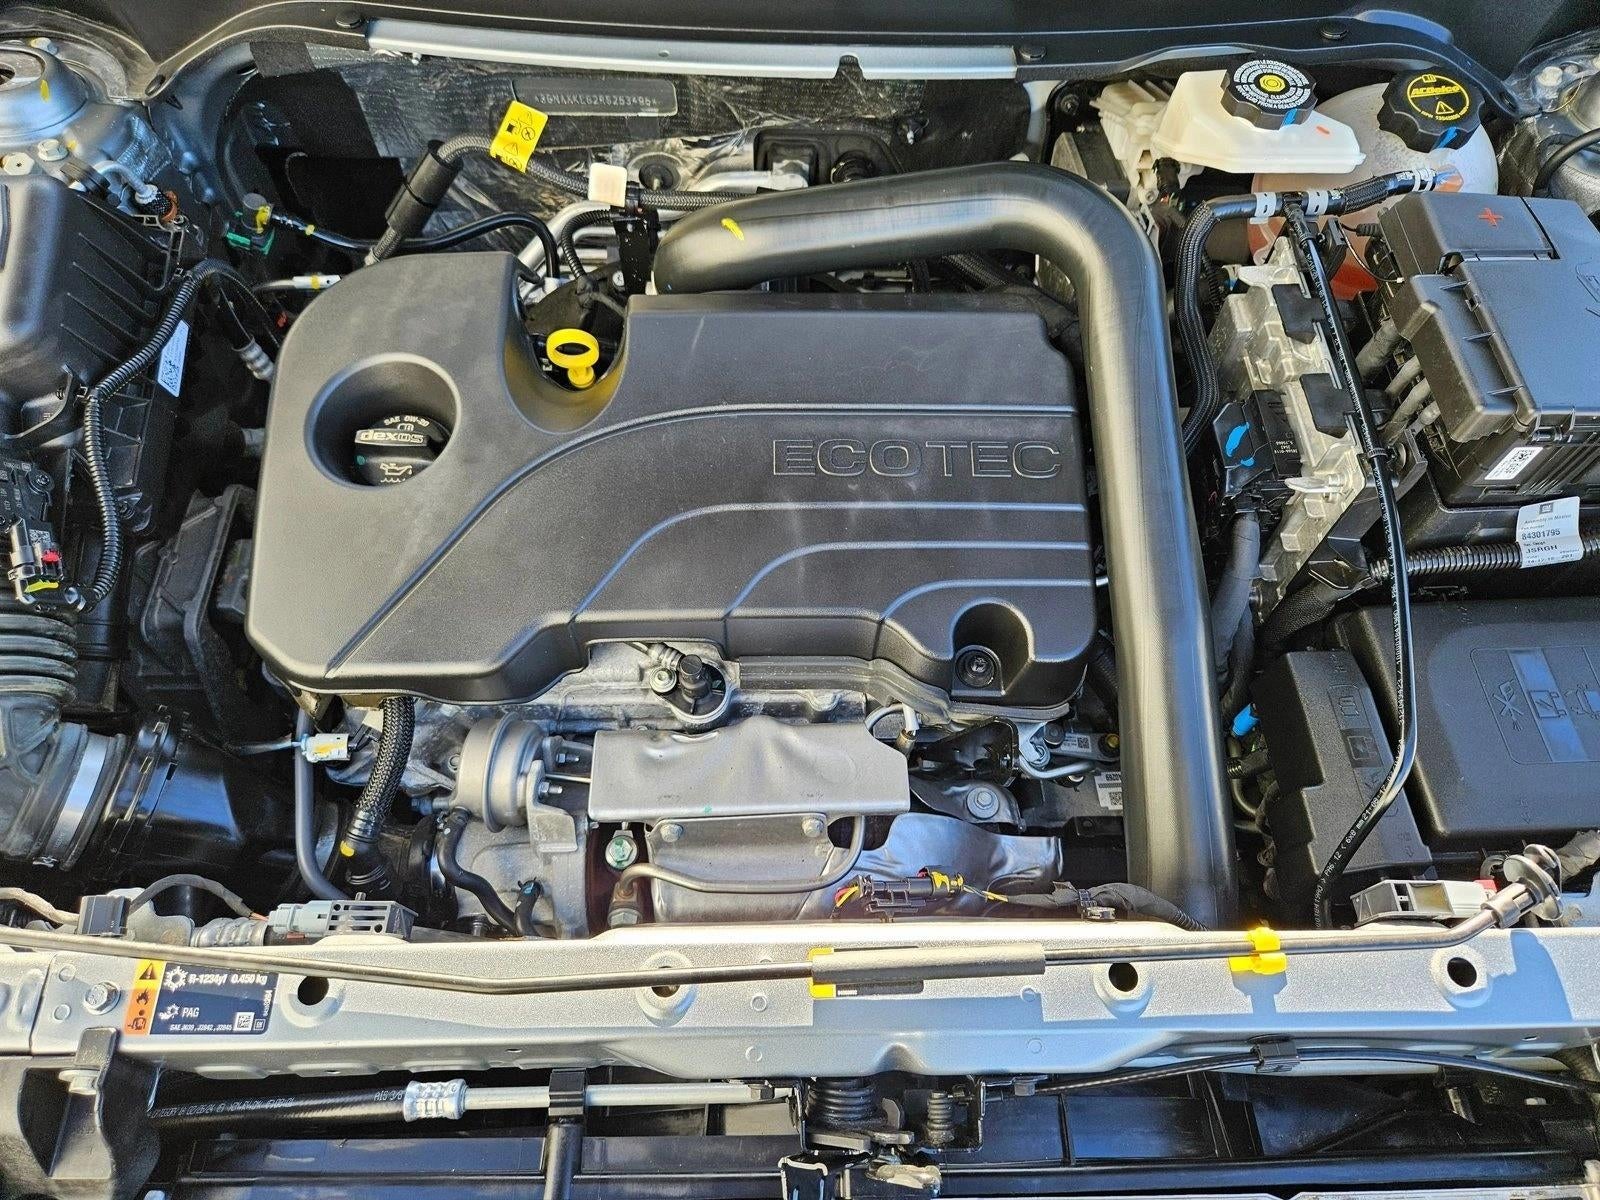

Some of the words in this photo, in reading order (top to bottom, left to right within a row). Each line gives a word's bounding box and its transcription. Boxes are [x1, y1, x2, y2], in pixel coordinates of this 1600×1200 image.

[360, 430, 424, 444] dexos
[773, 438, 1060, 478] ECOTEC
[1522, 528, 1561, 540] 84301795
[256, 974, 268, 986] kg
[182, 1008, 200, 1018] PAG
